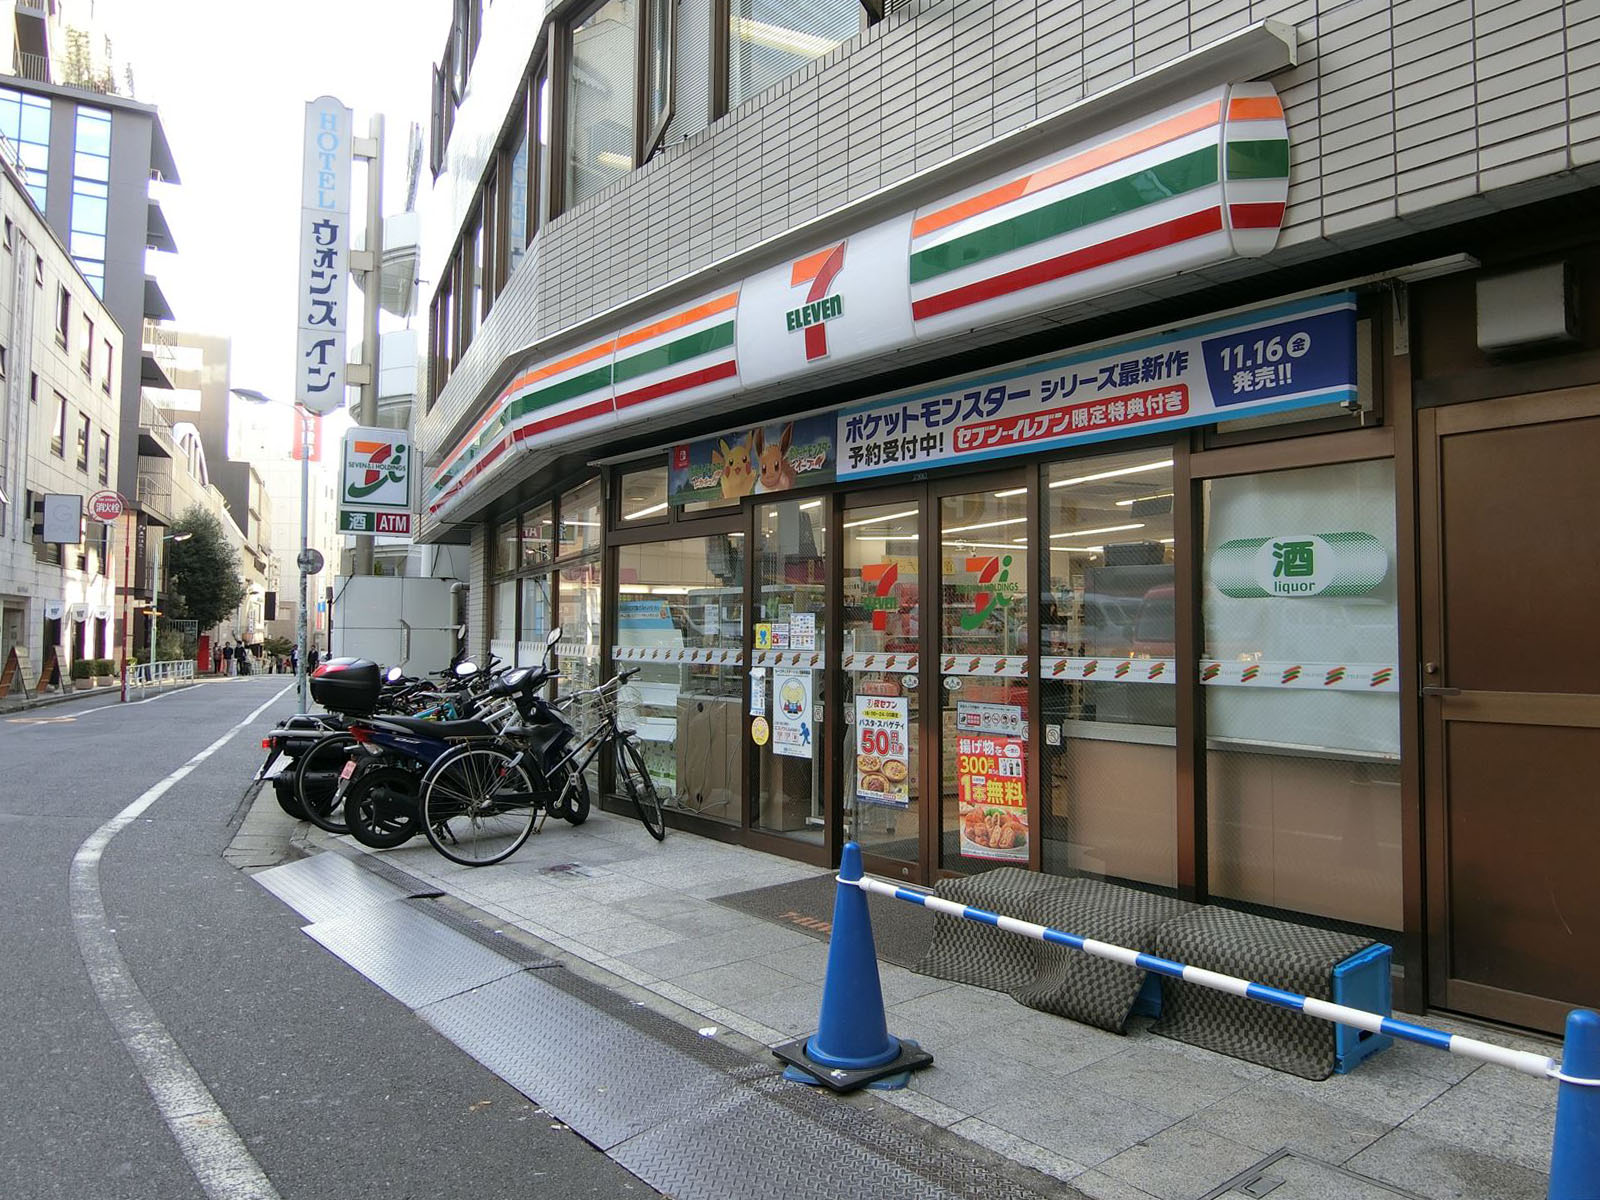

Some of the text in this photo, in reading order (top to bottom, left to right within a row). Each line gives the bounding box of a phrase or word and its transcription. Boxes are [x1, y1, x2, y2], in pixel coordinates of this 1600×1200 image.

[317, 110, 338, 209] HOTEL
[848, 432, 944, 469] 予約受付中!
[375, 464, 406, 472] HOLDINGS
[96, 502, 120, 513] 消火栓
[349, 513, 367, 530] 酒
[379, 515, 407, 531] ATM
[1272, 541, 1314, 577] 酒
[1274, 581, 1316, 594] liquor
